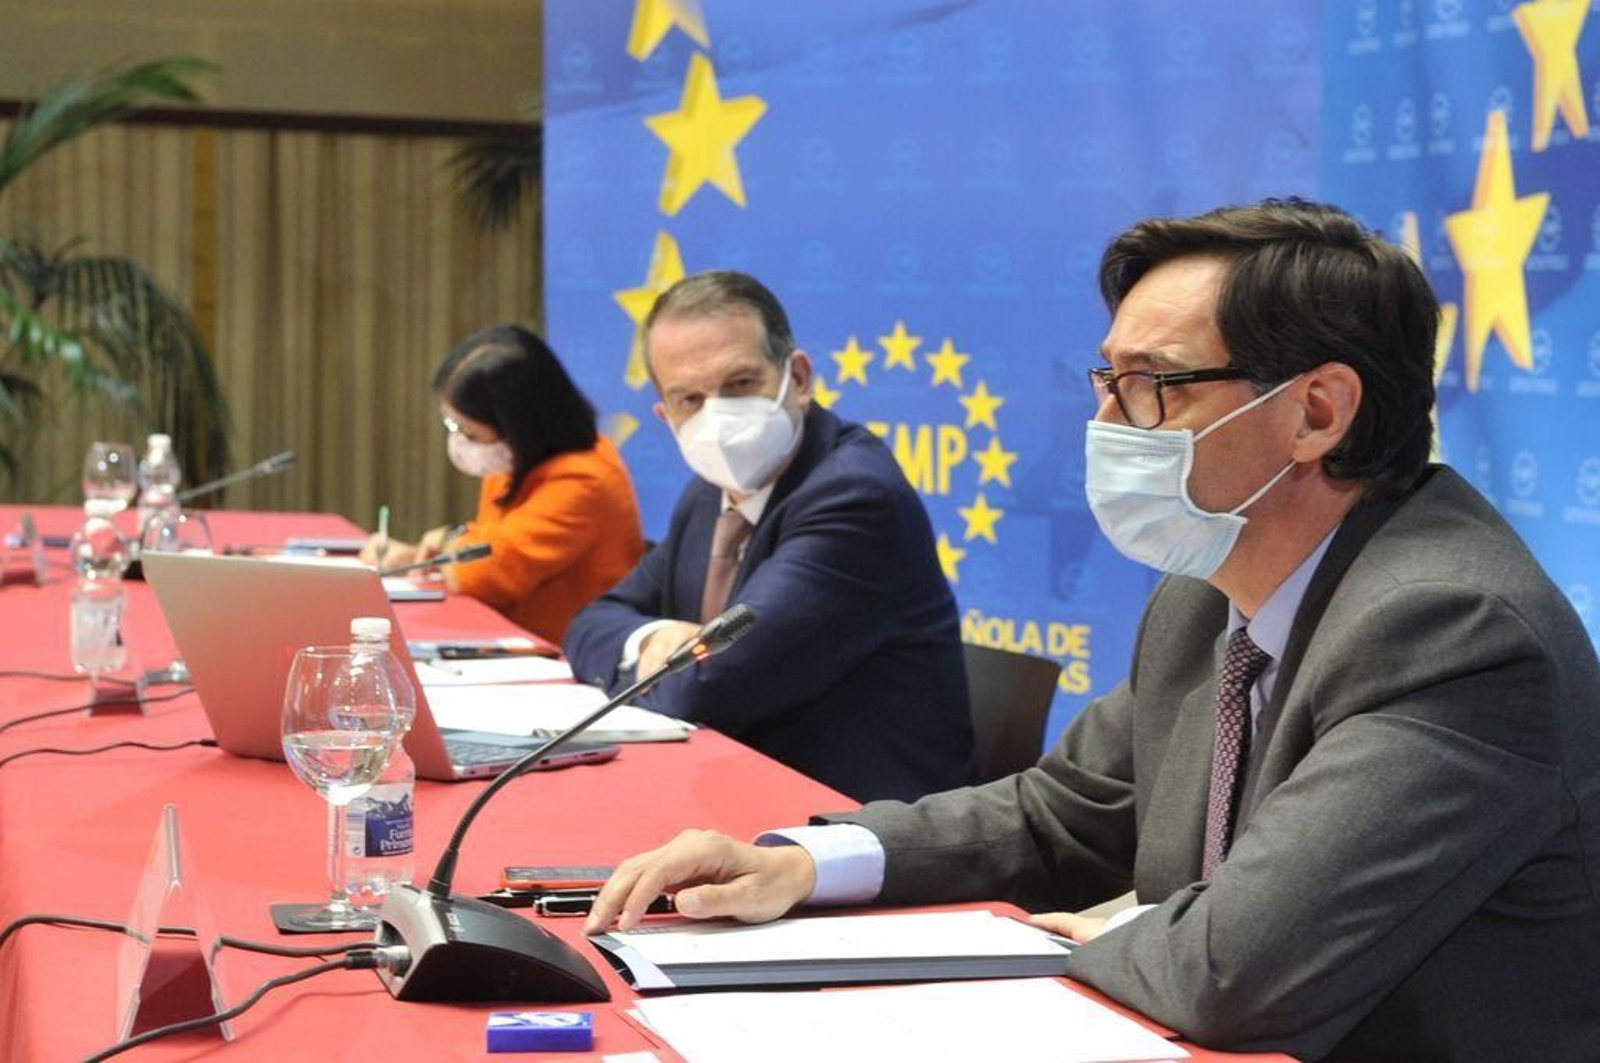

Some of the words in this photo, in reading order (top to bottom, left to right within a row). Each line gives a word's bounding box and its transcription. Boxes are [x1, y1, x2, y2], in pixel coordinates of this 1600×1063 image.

[866, 422, 967, 495] MP
[1047, 622, 1091, 658] DE
[1058, 660, 1091, 694] S
